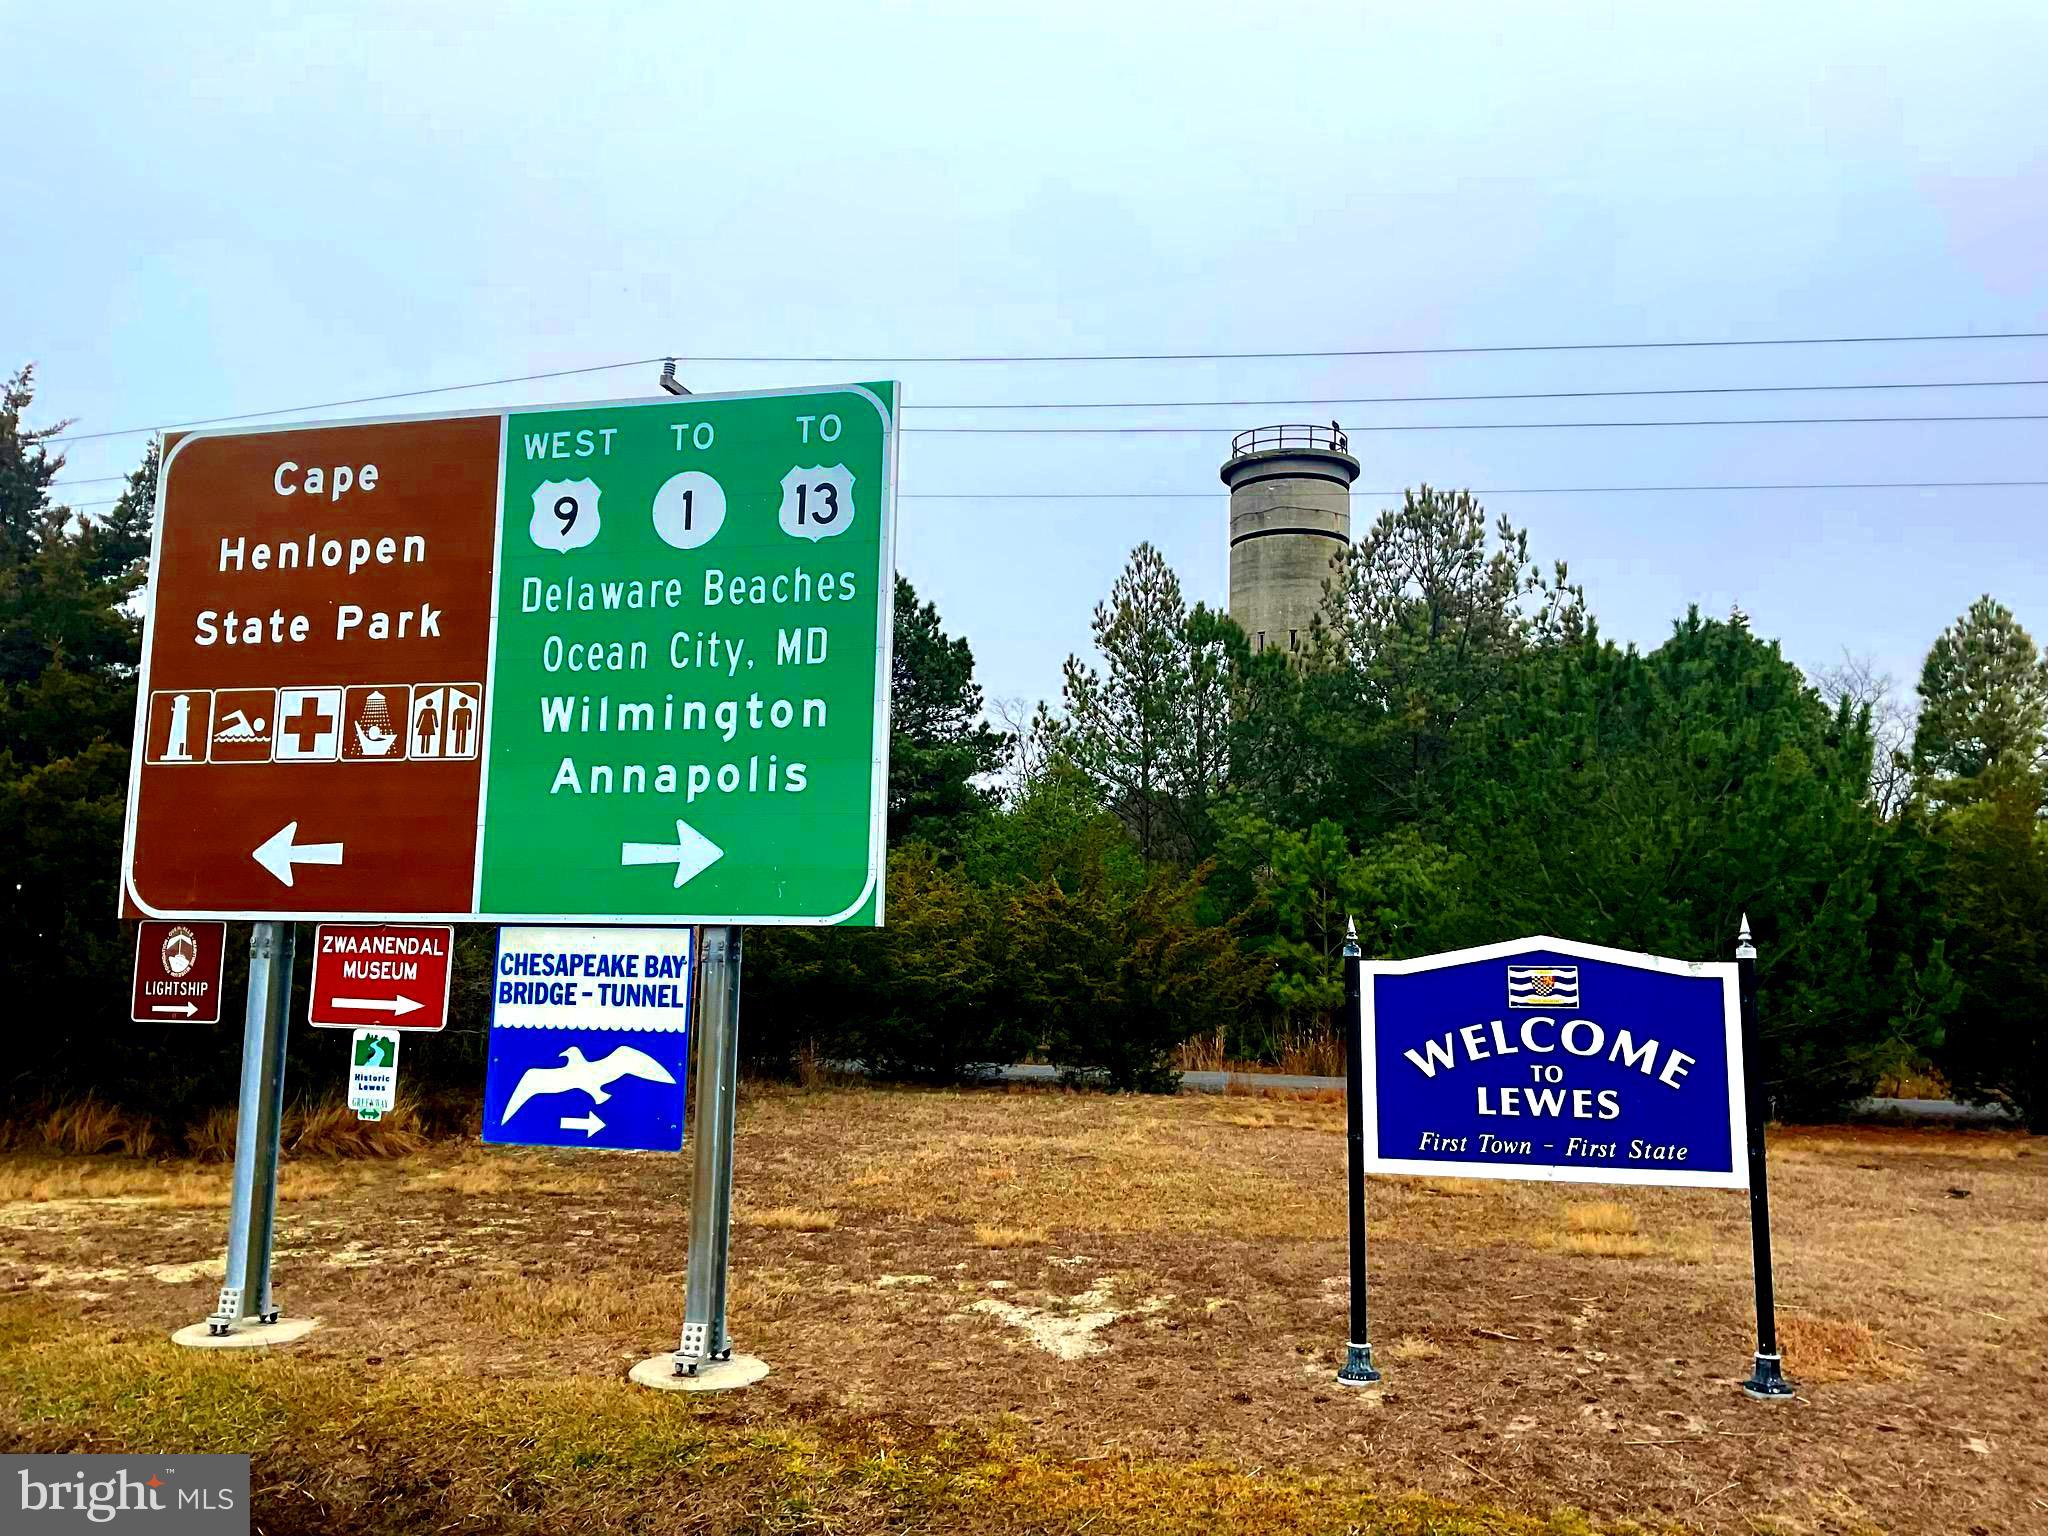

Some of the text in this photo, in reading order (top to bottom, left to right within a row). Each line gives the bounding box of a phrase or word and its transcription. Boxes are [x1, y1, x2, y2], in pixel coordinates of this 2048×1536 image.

[525, 429, 617, 460] WEST
[671, 422, 714, 451] TO
[797, 414, 842, 443] TO
[274, 461, 379, 502] Cape
[553, 496, 579, 537] 9
[682, 490, 693, 531] 1
[796, 482, 839, 525] 13
[219, 533, 425, 575] Henlopen
[522, 566, 856, 613] Delaware Beaches
[194, 602, 442, 646] State Park
[543, 627, 828, 677] Ocean City, MD
[540, 692, 827, 743] Wilmington
[550, 754, 808, 804] Annapolis
[322, 935, 444, 956] ZWAANENDAL
[343, 960, 418, 981] MUSEUM
[500, 952, 686, 979] CHESAPEAKE BAY
[145, 980, 209, 997] LIGHTSHIP
[1403, 1016, 1696, 1090] WELCOME
[354, 1073, 390, 1083] Historic
[358, 1082, 386, 1092] Lewes
[1530, 1064, 1564, 1084] TO
[1477, 1086, 1620, 1120] LEWES
[1418, 1131, 1468, 1152] First
[1478, 1134, 1532, 1155] Town
[1565, 1137, 1617, 1158] First
[1628, 1139, 1688, 1161] State
